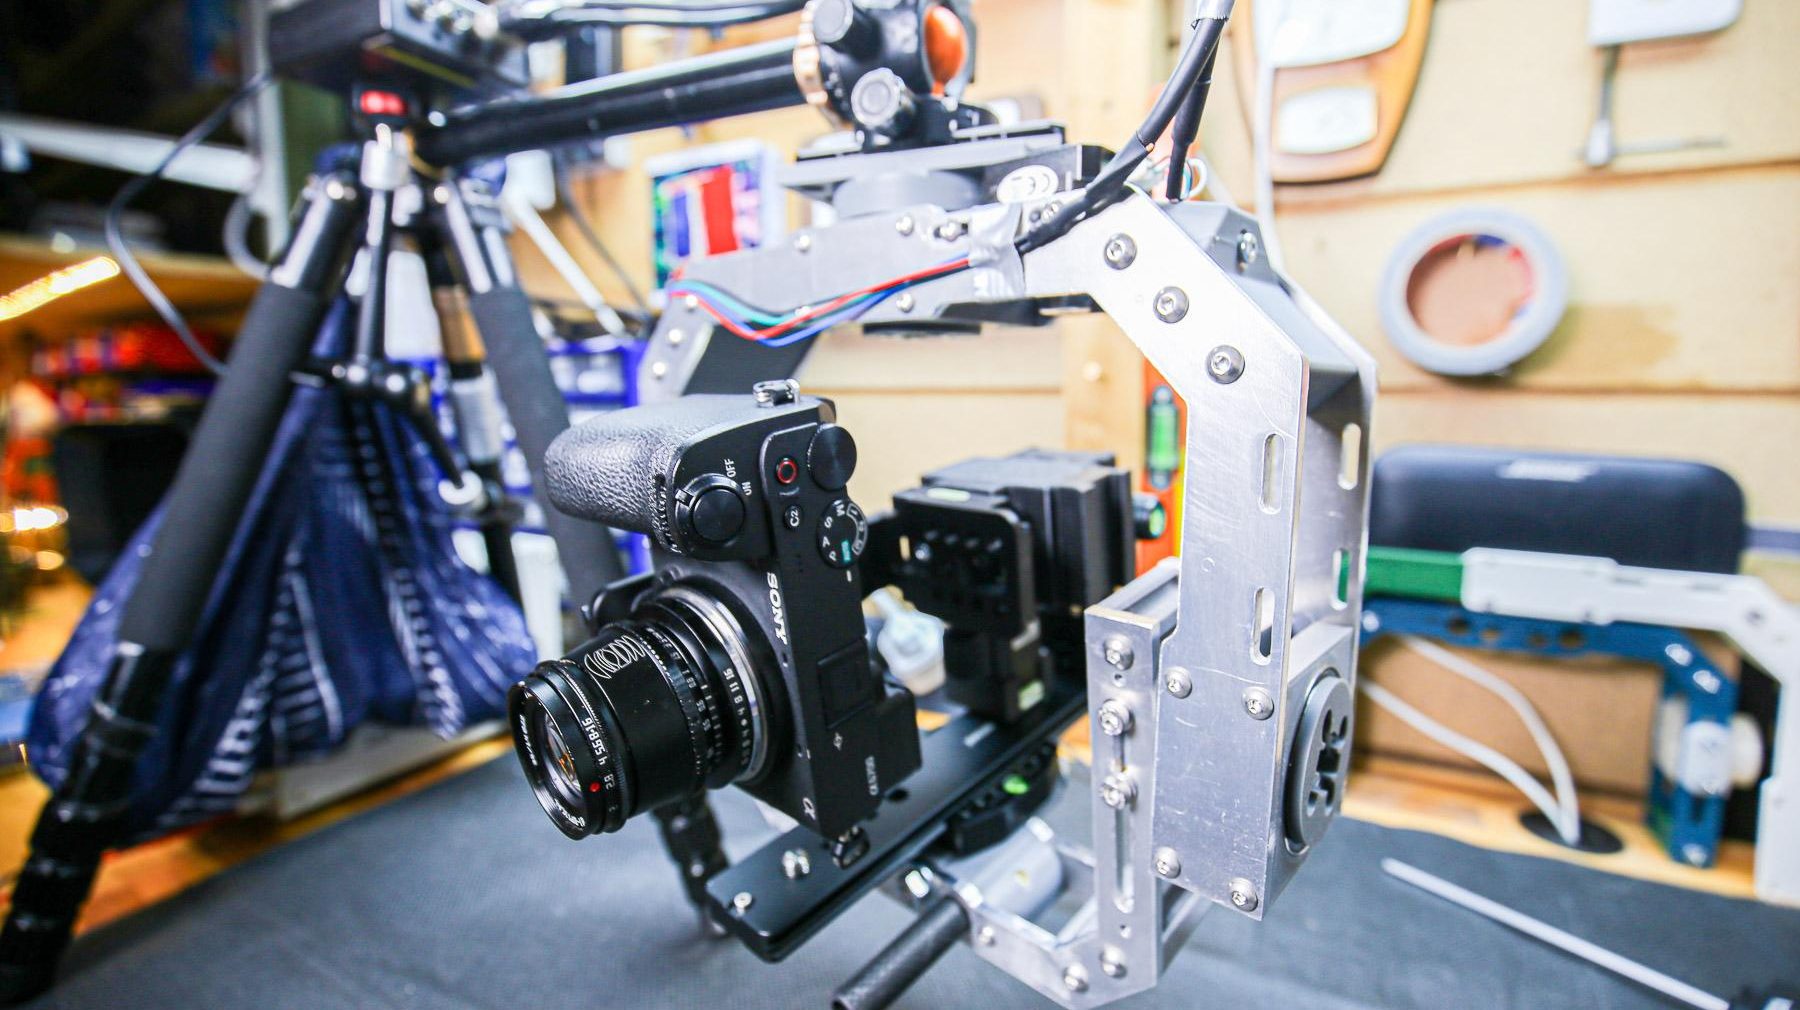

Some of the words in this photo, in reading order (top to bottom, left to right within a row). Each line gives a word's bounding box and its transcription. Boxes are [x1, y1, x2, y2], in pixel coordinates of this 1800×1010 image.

[724, 458, 737, 478] OFF
[790, 508, 801, 527] C2
[824, 516, 833, 528] S
[822, 536, 831, 548] A
[829, 550, 837, 562] P
[766, 571, 788, 645] SONY
[723, 668, 735, 679] 16
[730, 681, 740, 692] 11
[734, 695, 743, 704] 8
[598, 755, 608, 765] 4
